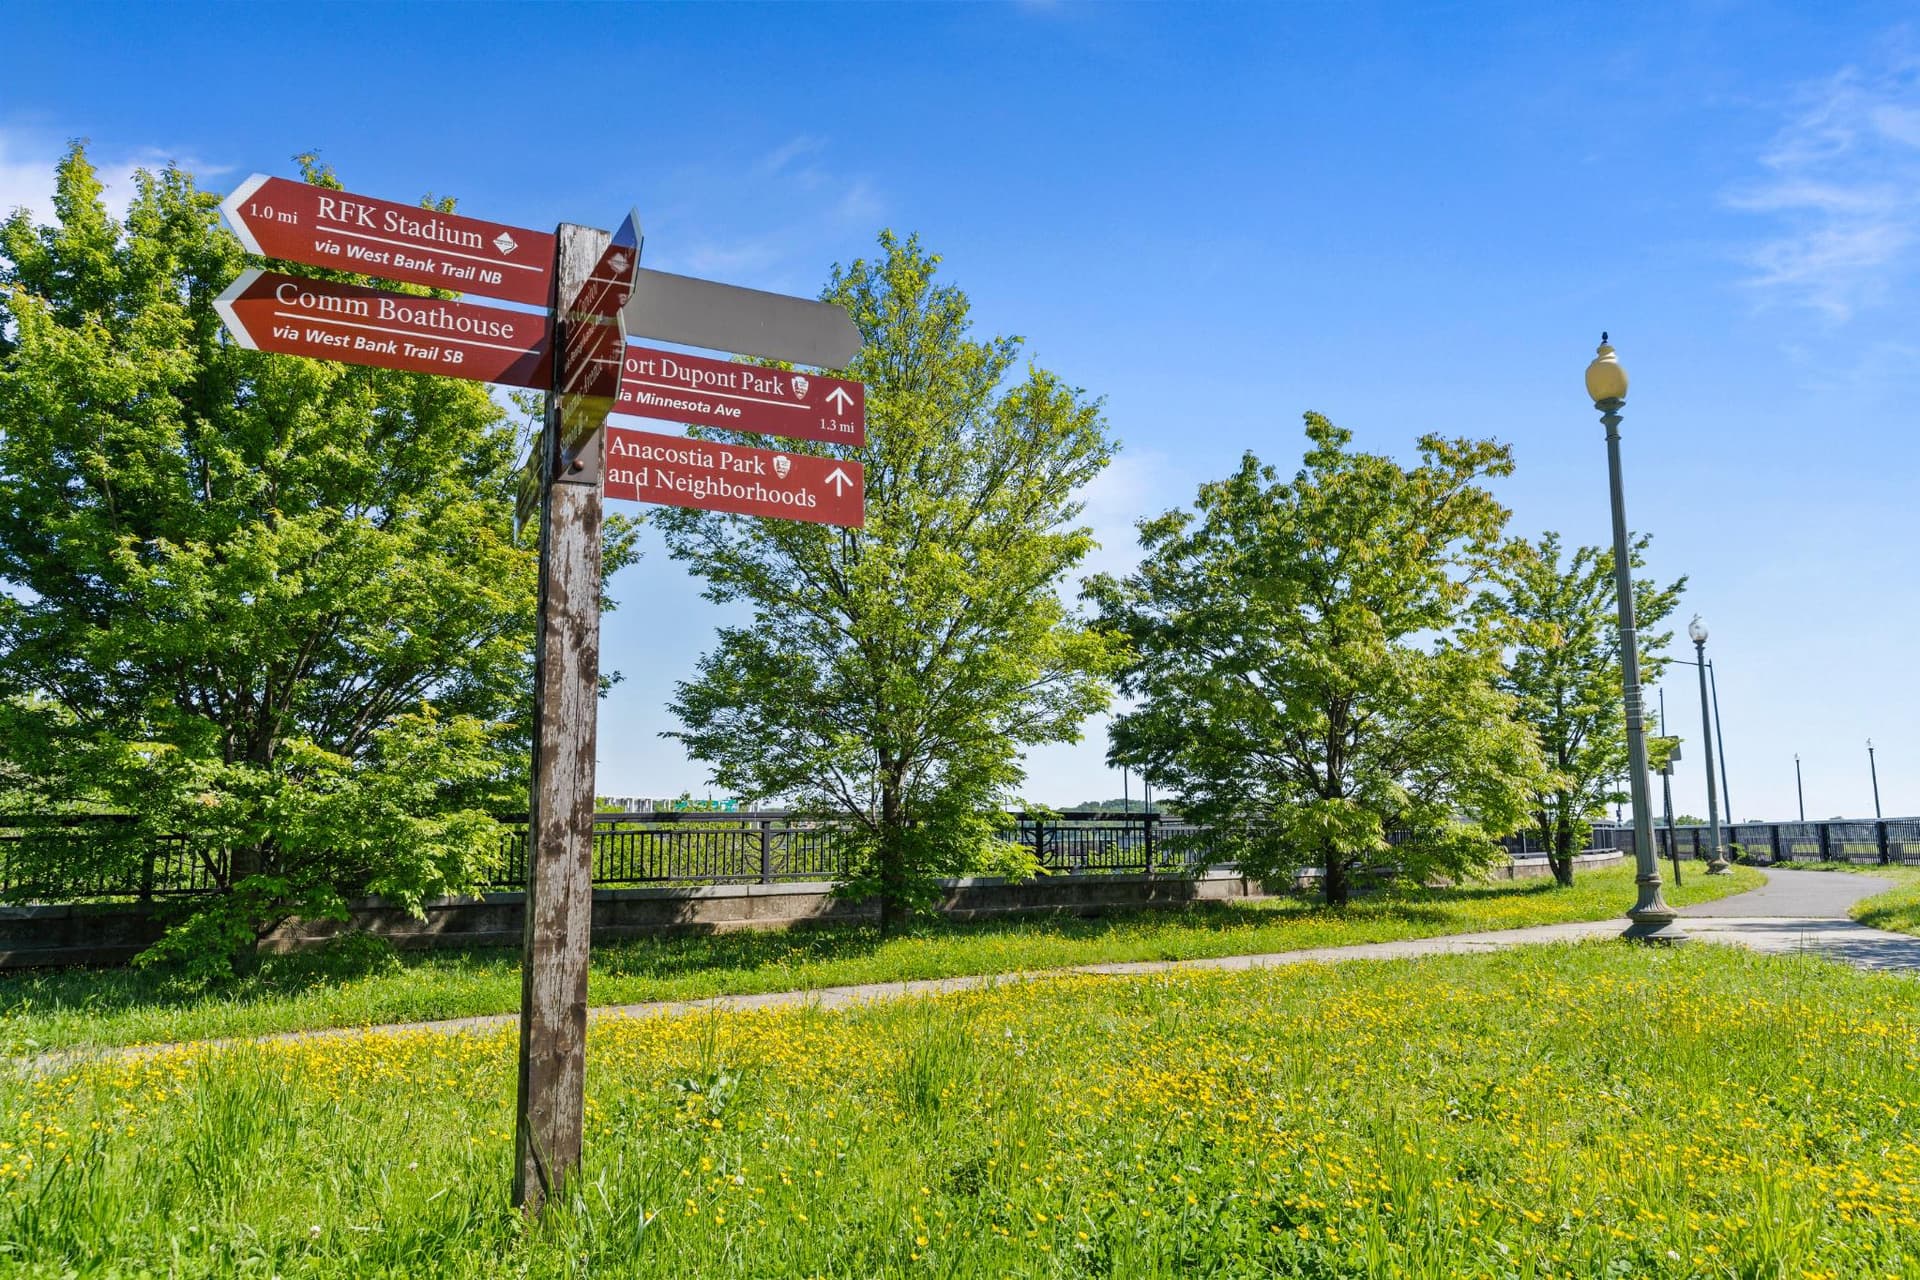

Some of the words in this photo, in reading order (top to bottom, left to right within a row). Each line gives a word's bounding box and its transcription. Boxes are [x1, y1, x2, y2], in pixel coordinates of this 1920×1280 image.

[250, 203, 274, 219] 1.0
[278, 211, 298, 225] mi
[316, 196, 376, 229] RFK
[383, 210, 483, 249] Stadium
[314, 239, 341, 255] via
[346, 244, 391, 265] West
[393, 253, 436, 273] Bank
[440, 262, 476, 280] Trail
[478, 269, 503, 285] NB
[275, 282, 369, 317] Comm
[377, 298, 514, 339] Boathouse
[272, 325, 300, 341] via
[305, 328, 351, 348] West
[353, 336, 398, 355] Bank
[403, 343, 440, 361] Trail
[442, 349, 465, 364] SB
[625, 358, 656, 376] ort
[660, 358, 737, 388] Dupont
[742, 371, 784, 396] Park
[618, 388, 633, 402] ia
[635, 391, 711, 414] Minnesota
[713, 403, 742, 418] Ave
[819, 418, 837, 432] 1.3
[839, 421, 855, 433] mi
[609, 435, 715, 470] Anacostia
[719, 450, 766, 476] Park
[608, 466, 649, 488] and
[655, 468, 817, 508] Neighborhoods
